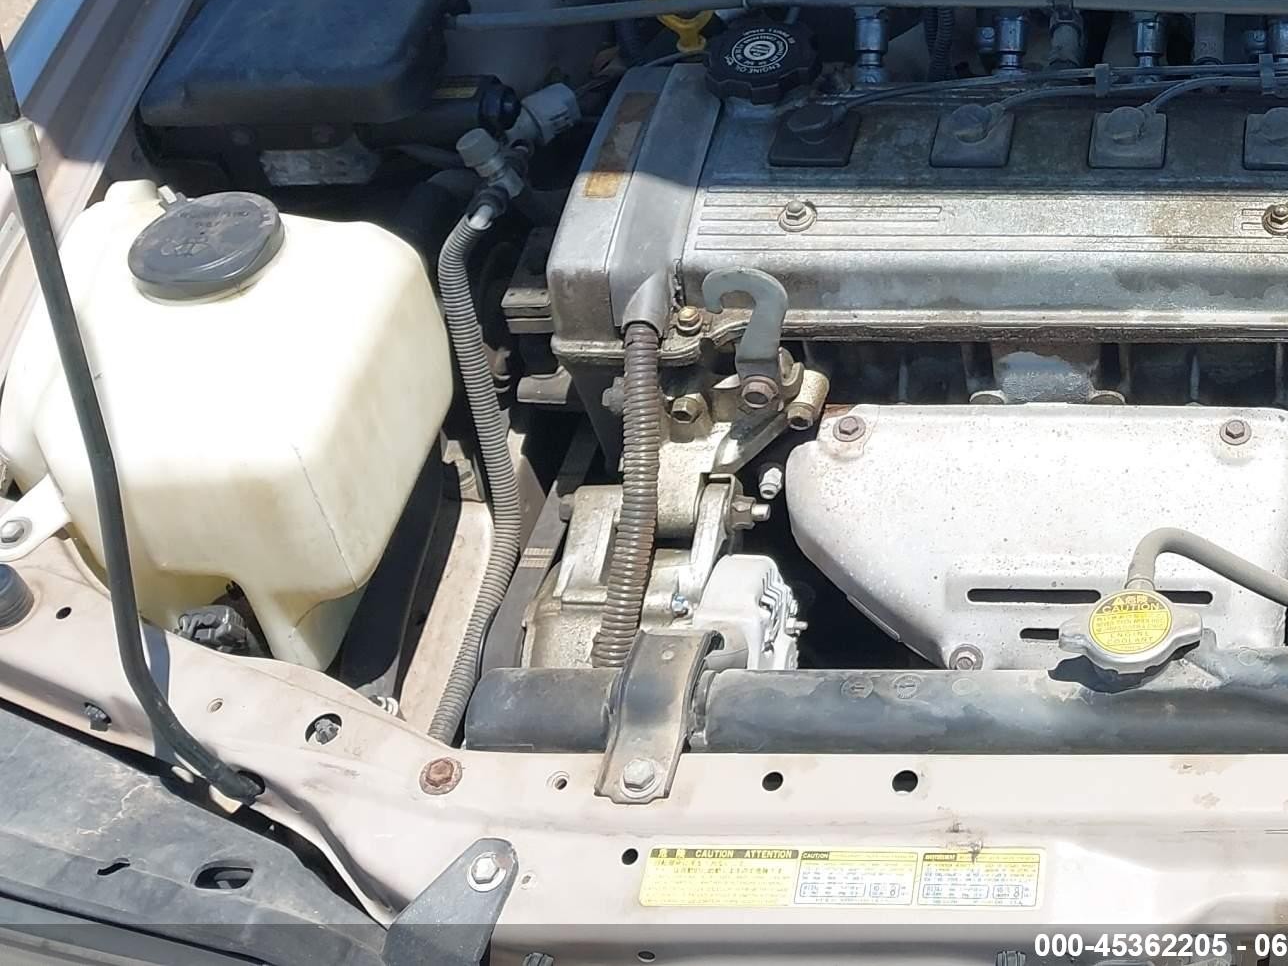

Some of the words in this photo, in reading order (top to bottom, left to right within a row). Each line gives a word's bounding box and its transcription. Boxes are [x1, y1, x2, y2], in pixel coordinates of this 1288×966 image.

[1102, 602, 1160, 614] CAUTION
[695, 849, 734, 859] CAUTION
[743, 850, 793, 859] ATTENTION
[802, 852, 829, 860] CAUTION
